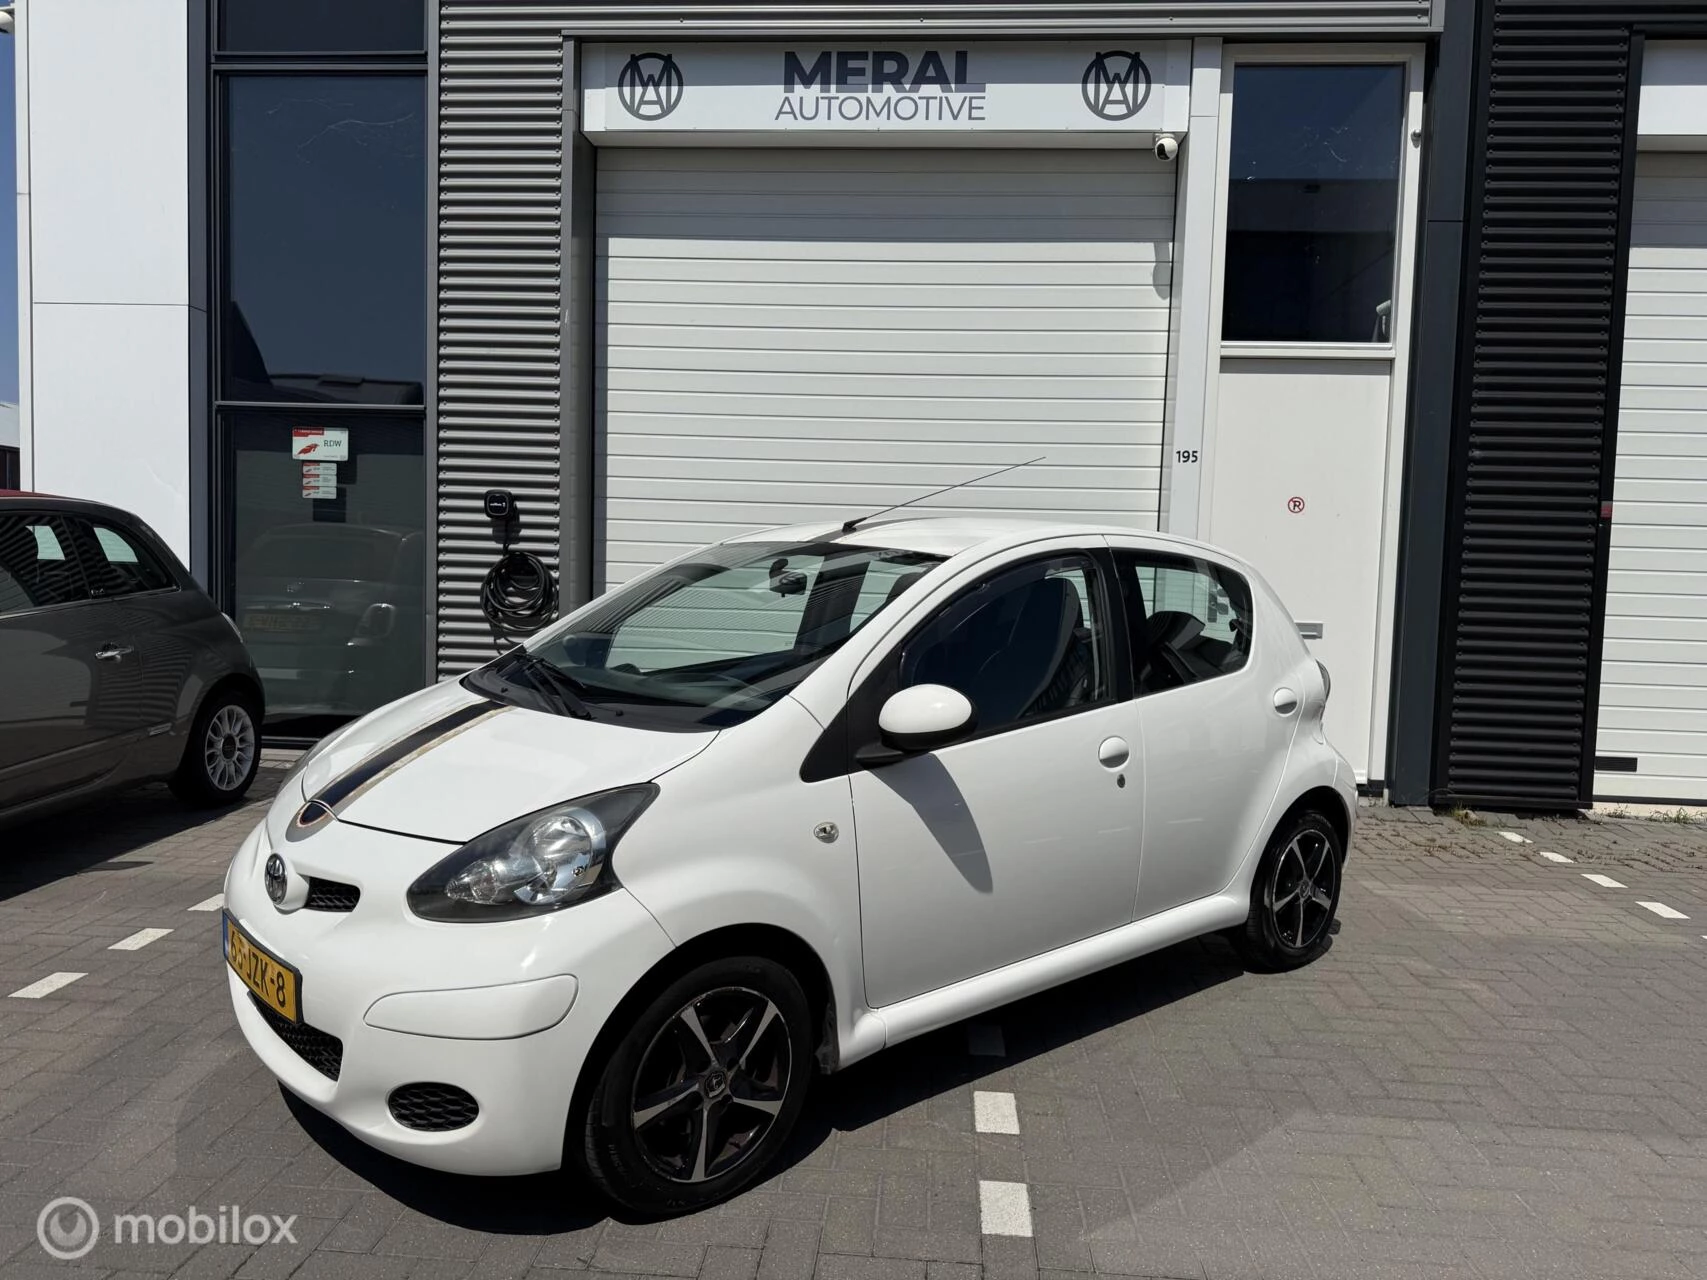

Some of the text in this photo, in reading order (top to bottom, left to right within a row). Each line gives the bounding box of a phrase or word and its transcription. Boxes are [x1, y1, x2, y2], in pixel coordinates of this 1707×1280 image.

[784, 51, 986, 93] MERAL
[775, 96, 986, 121] AUTOMOTIVE
[323, 439, 342, 449] RDW
[1176, 450, 1199, 464] 195
